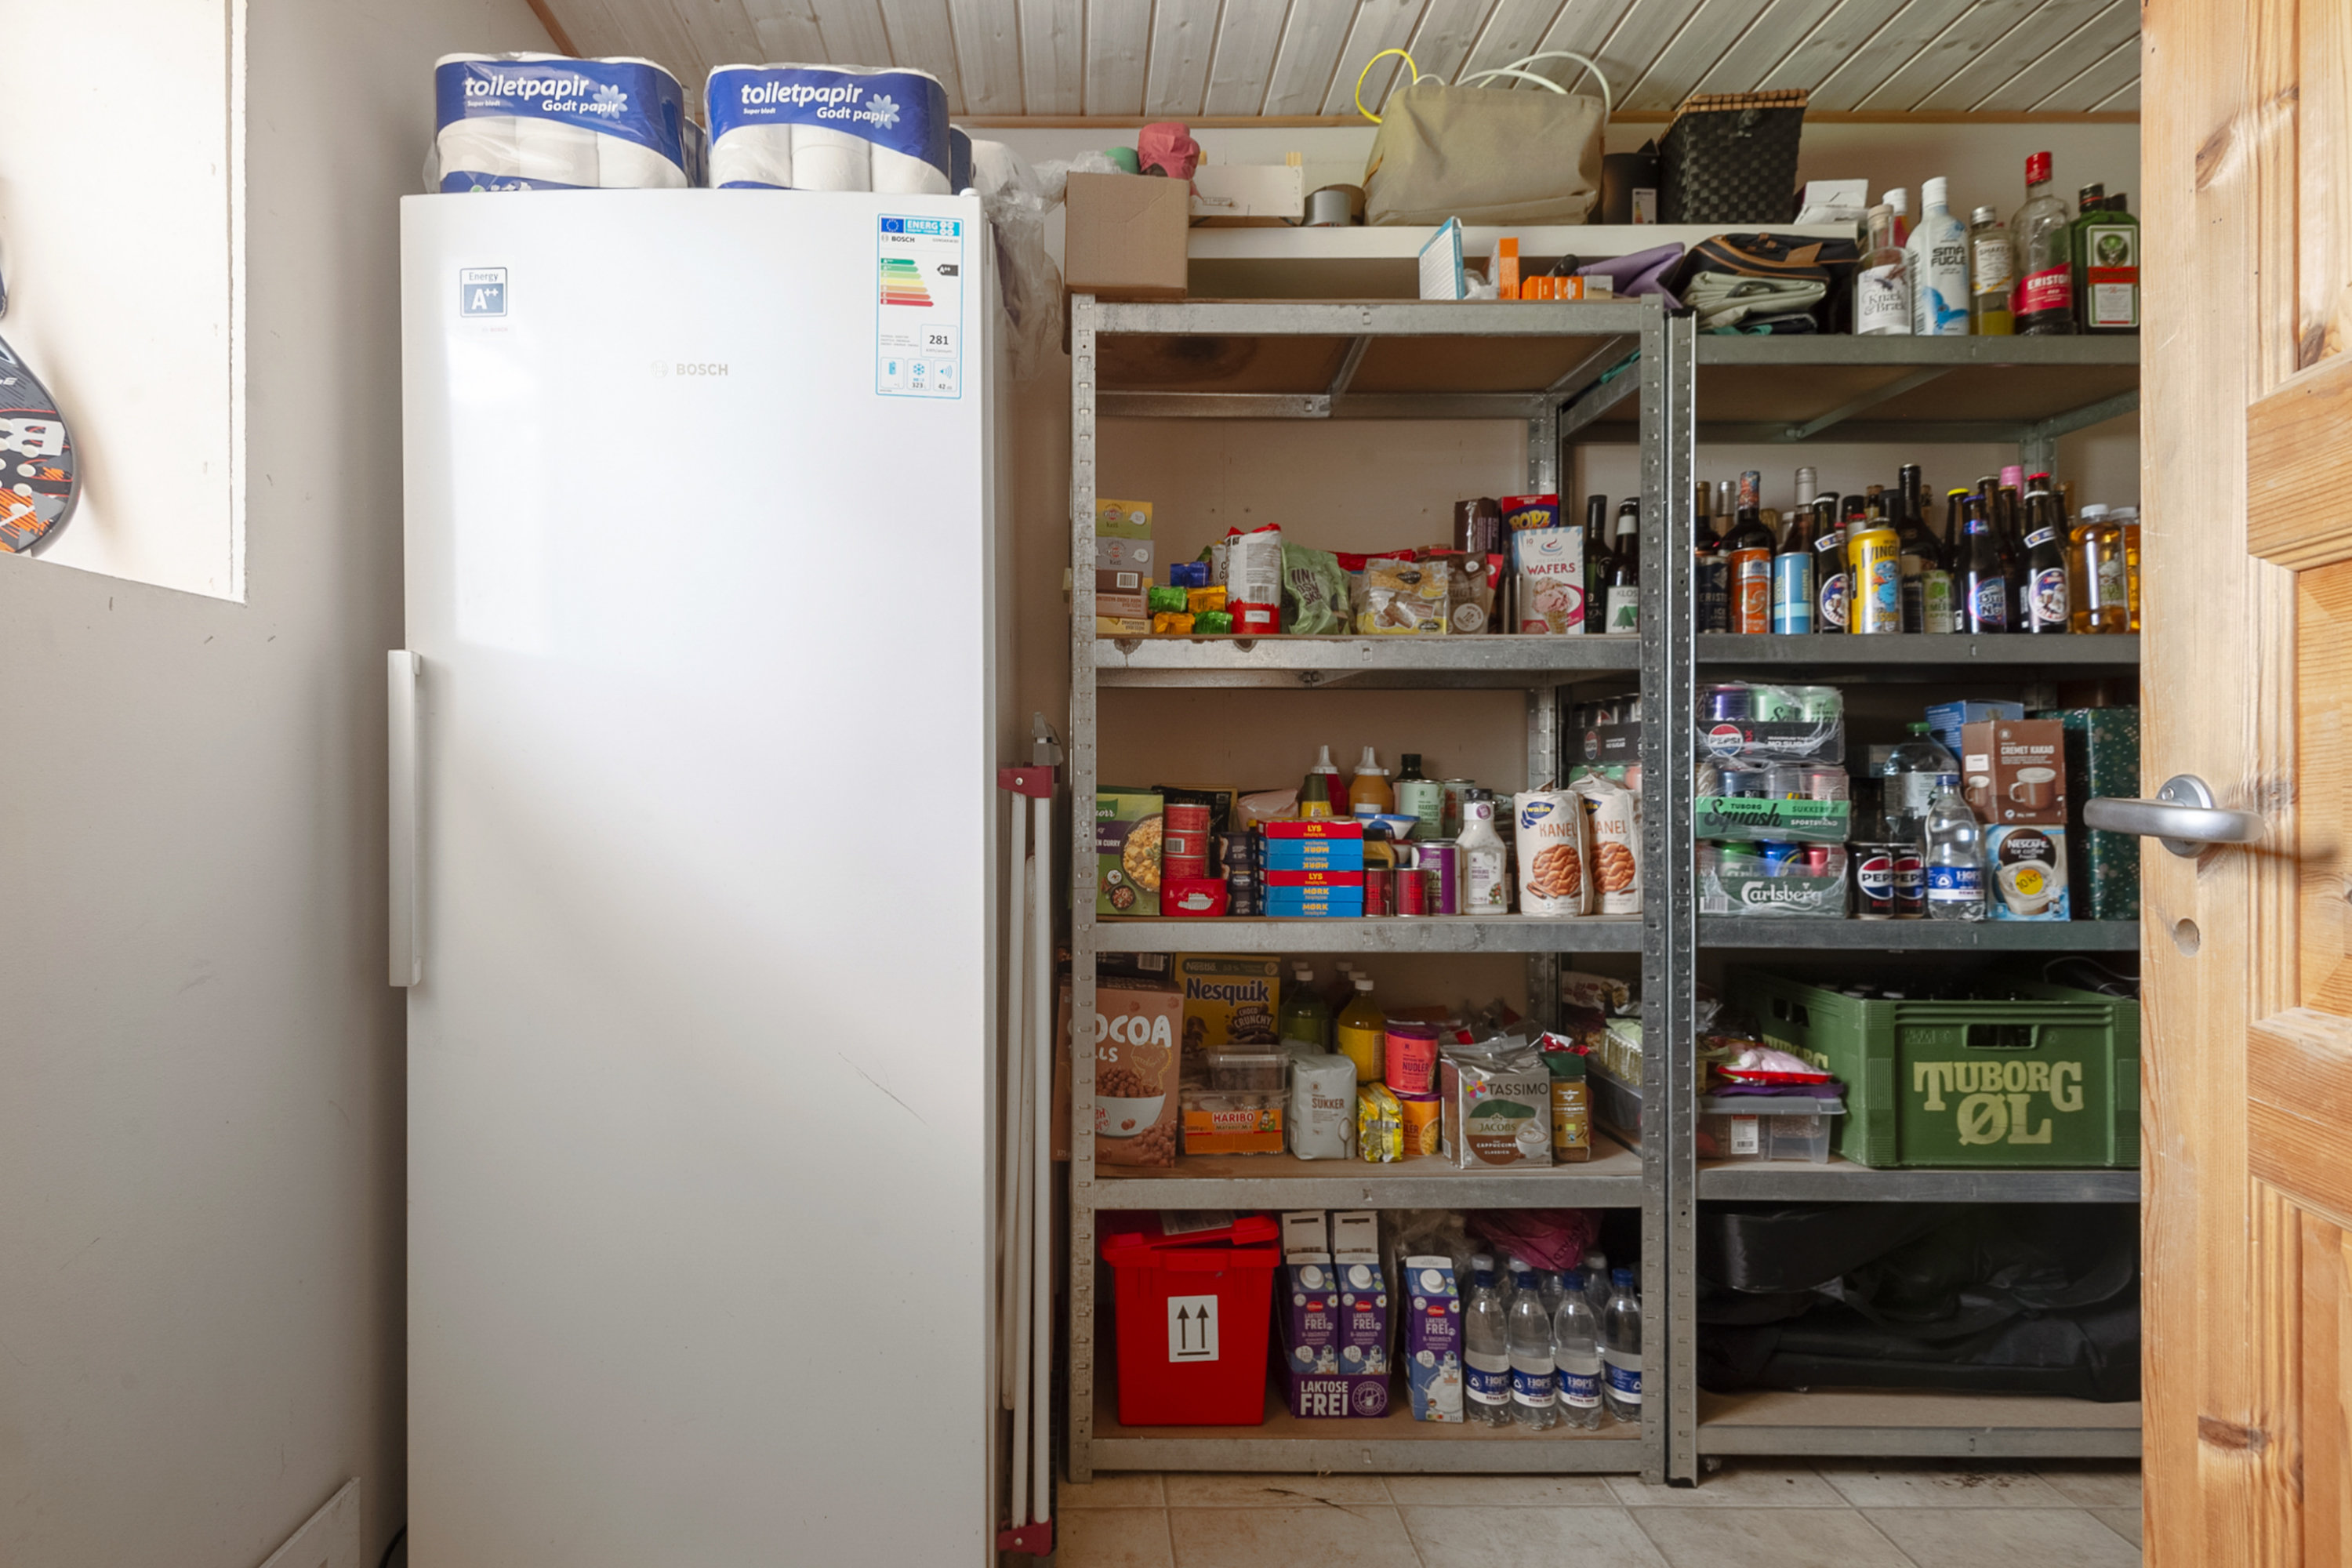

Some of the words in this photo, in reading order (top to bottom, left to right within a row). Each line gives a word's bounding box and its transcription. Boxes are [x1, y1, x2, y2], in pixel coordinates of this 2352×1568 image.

[465, 75, 590, 100] toiletpapir
[741, 82, 863, 107] toiletpapir
[542, 100, 577, 111] Godt
[579, 101, 618, 114] papir
[817, 107, 851, 118] Godt
[853, 110, 891, 124] papir
[907, 220, 938, 230] ENERG
[469, 272, 499, 282] Energy
[471, 288, 499, 310] A++
[929, 335, 949, 345] 281
[677, 363, 728, 376] BOSCH
[1526, 562, 1576, 575] WAFERS
[2001, 746, 2028, 755] CREMET
[1704, 798, 1782, 833] Squash
[1539, 822, 1577, 837] KANEL
[2016, 878, 2029, 889] 10
[1741, 880, 1823, 906] Carlsberg
[1186, 977, 1270, 1007] Nesquik
[1233, 1014, 1273, 1029] CRUNCHY
[1403, 1062, 1429, 1073] NUDLER
[1487, 1082, 1549, 1096] TASSIMO
[1914, 1061, 2084, 1112] TUBORG
[1312, 1098, 1345, 1109] SUKKER
[1214, 1112, 1254, 1123] HARIBO
[1956, 1092, 2053, 1146] ØL
[1479, 1123, 1517, 1132] JACOBS
[1305, 1319, 1327, 1330] FREI
[1353, 1319, 1374, 1330] FREI
[1425, 1323, 1448, 1334] FREI
[1301, 1381, 1348, 1393] LAKTOSE
[1527, 1377, 1552, 1386] HOPE
[1568, 1376, 1594, 1386] HOPE
[1301, 1393, 1348, 1416] FREI
